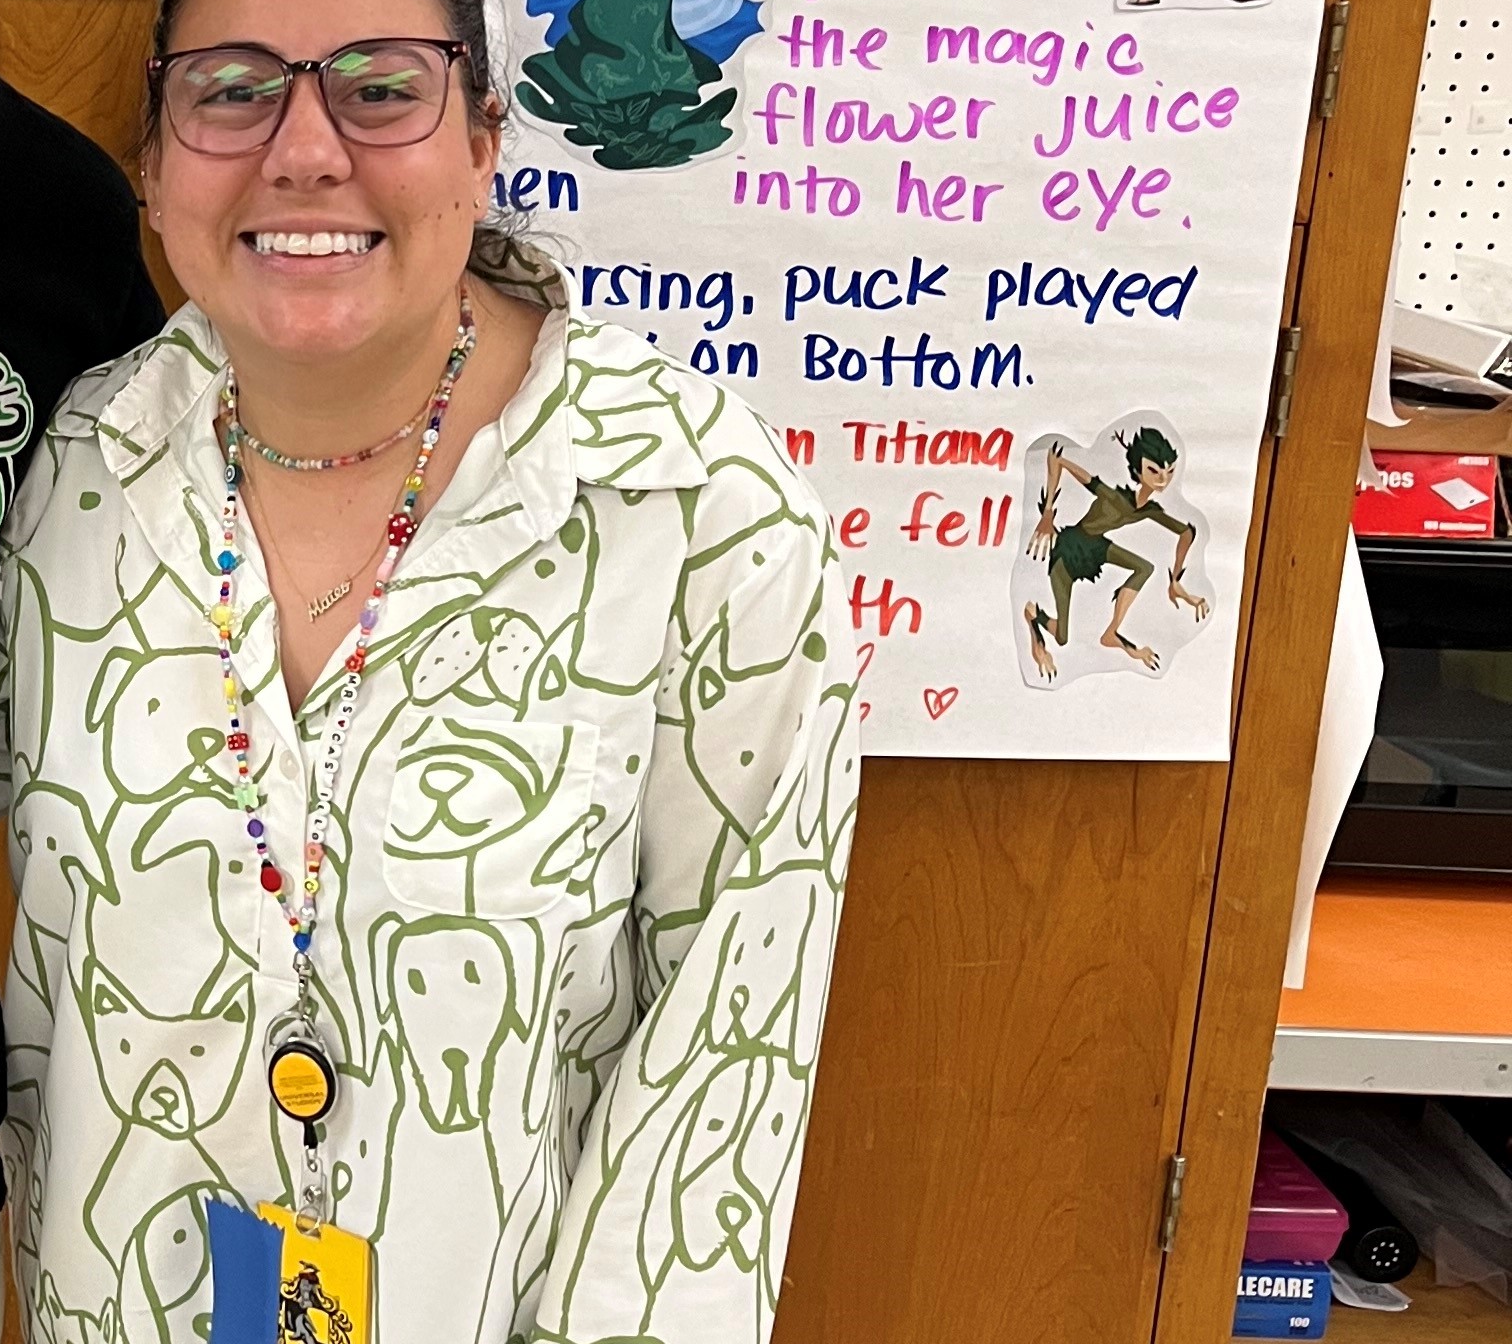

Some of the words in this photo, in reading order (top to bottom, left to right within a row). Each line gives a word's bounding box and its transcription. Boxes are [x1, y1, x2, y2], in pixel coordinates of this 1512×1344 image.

[776, 13, 888, 70] the
[926, 20, 1144, 86] magic
[753, 82, 996, 147] flower
[1034, 80, 1240, 157] juice
[732, 156, 861, 217] into
[896, 161, 1004, 224] her
[1042, 164, 1193, 232] eye.
[572, 262, 755, 332] rsing,
[786, 257, 947, 317] puck
[986, 263, 1199, 326] played
[691, 336, 759, 379] on
[842, 420, 1014, 471] Titiana
[900, 492, 1012, 547] fell
[849, 574, 922, 637] th
[343, 674, 357, 714] MRS
[312, 733, 341, 841] CASILLO
[1237, 1276, 1314, 1299] LECARE
